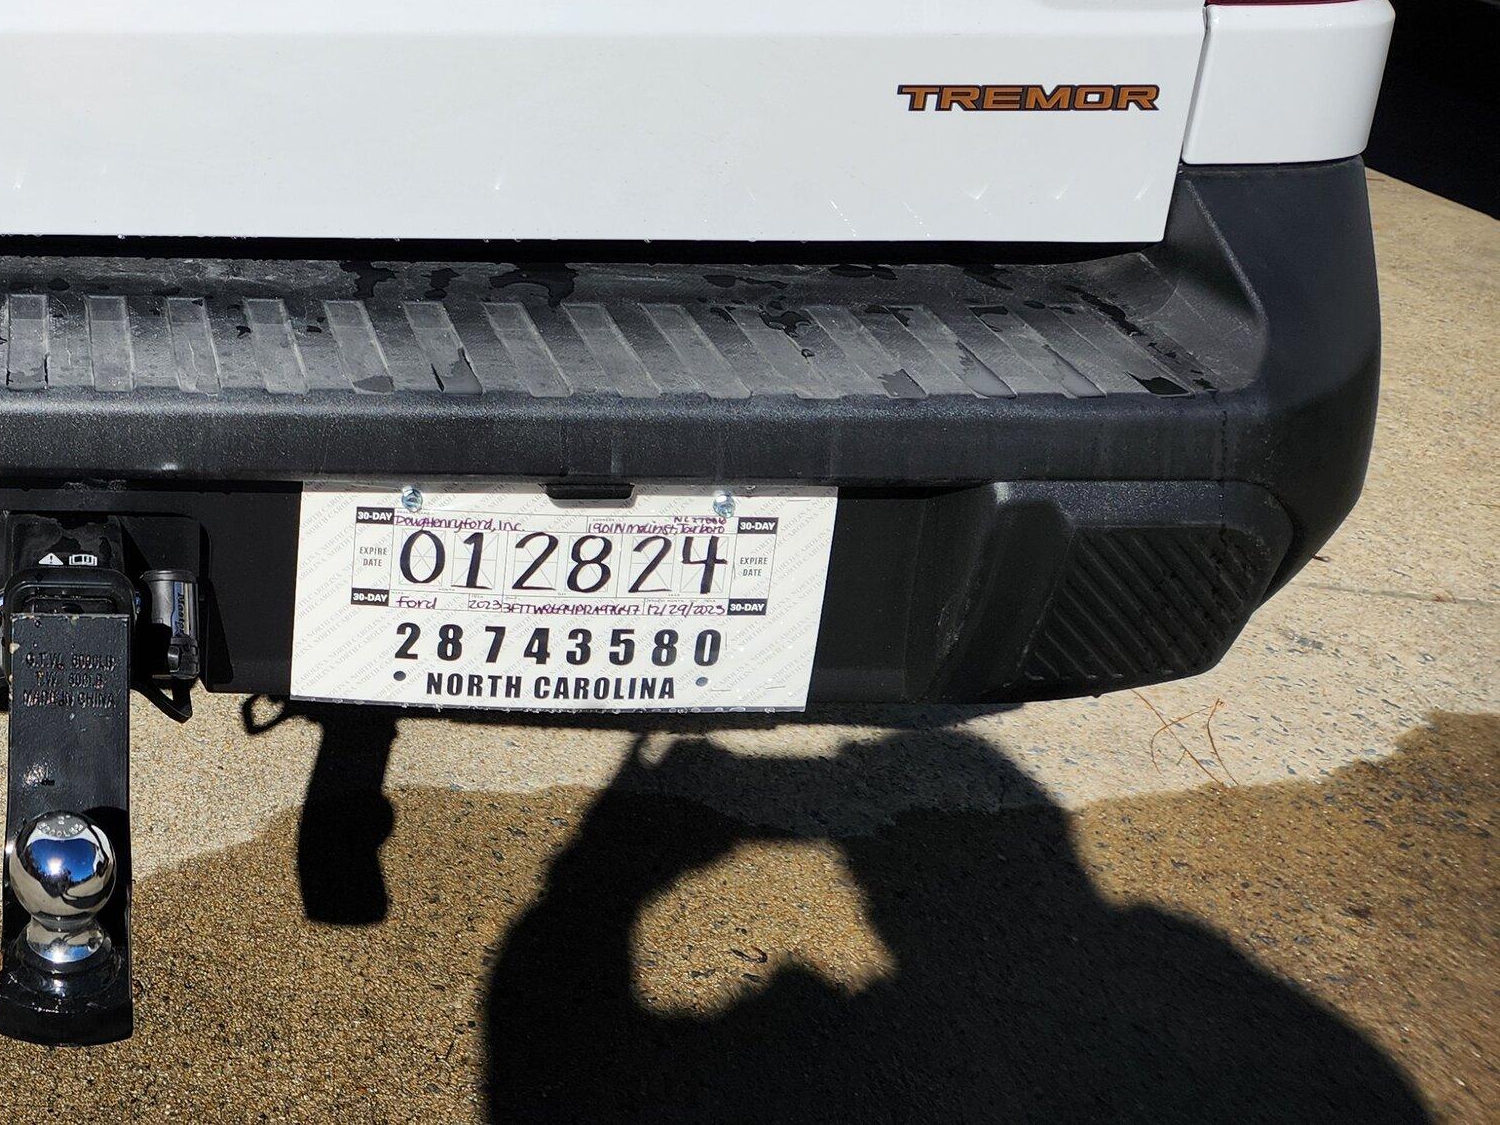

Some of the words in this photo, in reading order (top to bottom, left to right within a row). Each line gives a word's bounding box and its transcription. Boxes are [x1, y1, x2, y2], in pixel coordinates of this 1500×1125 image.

[897, 85, 1160, 111] TREMOR
[357, 511, 393, 521] 30-DAY
[739, 521, 776, 531] 30-DAY
[359, 547, 388, 556] EXPIRE
[362, 559, 382, 567] DATE
[739, 557, 768, 565] EXPIRE
[742, 568, 762, 576] DATE
[352, 592, 388, 602] 30-DAY
[729, 602, 766, 613] 30-DAY
[394, 622, 722, 666] 28743580
[426, 672, 522, 698] NORTH
[534, 676, 675, 699] CAROLINA
